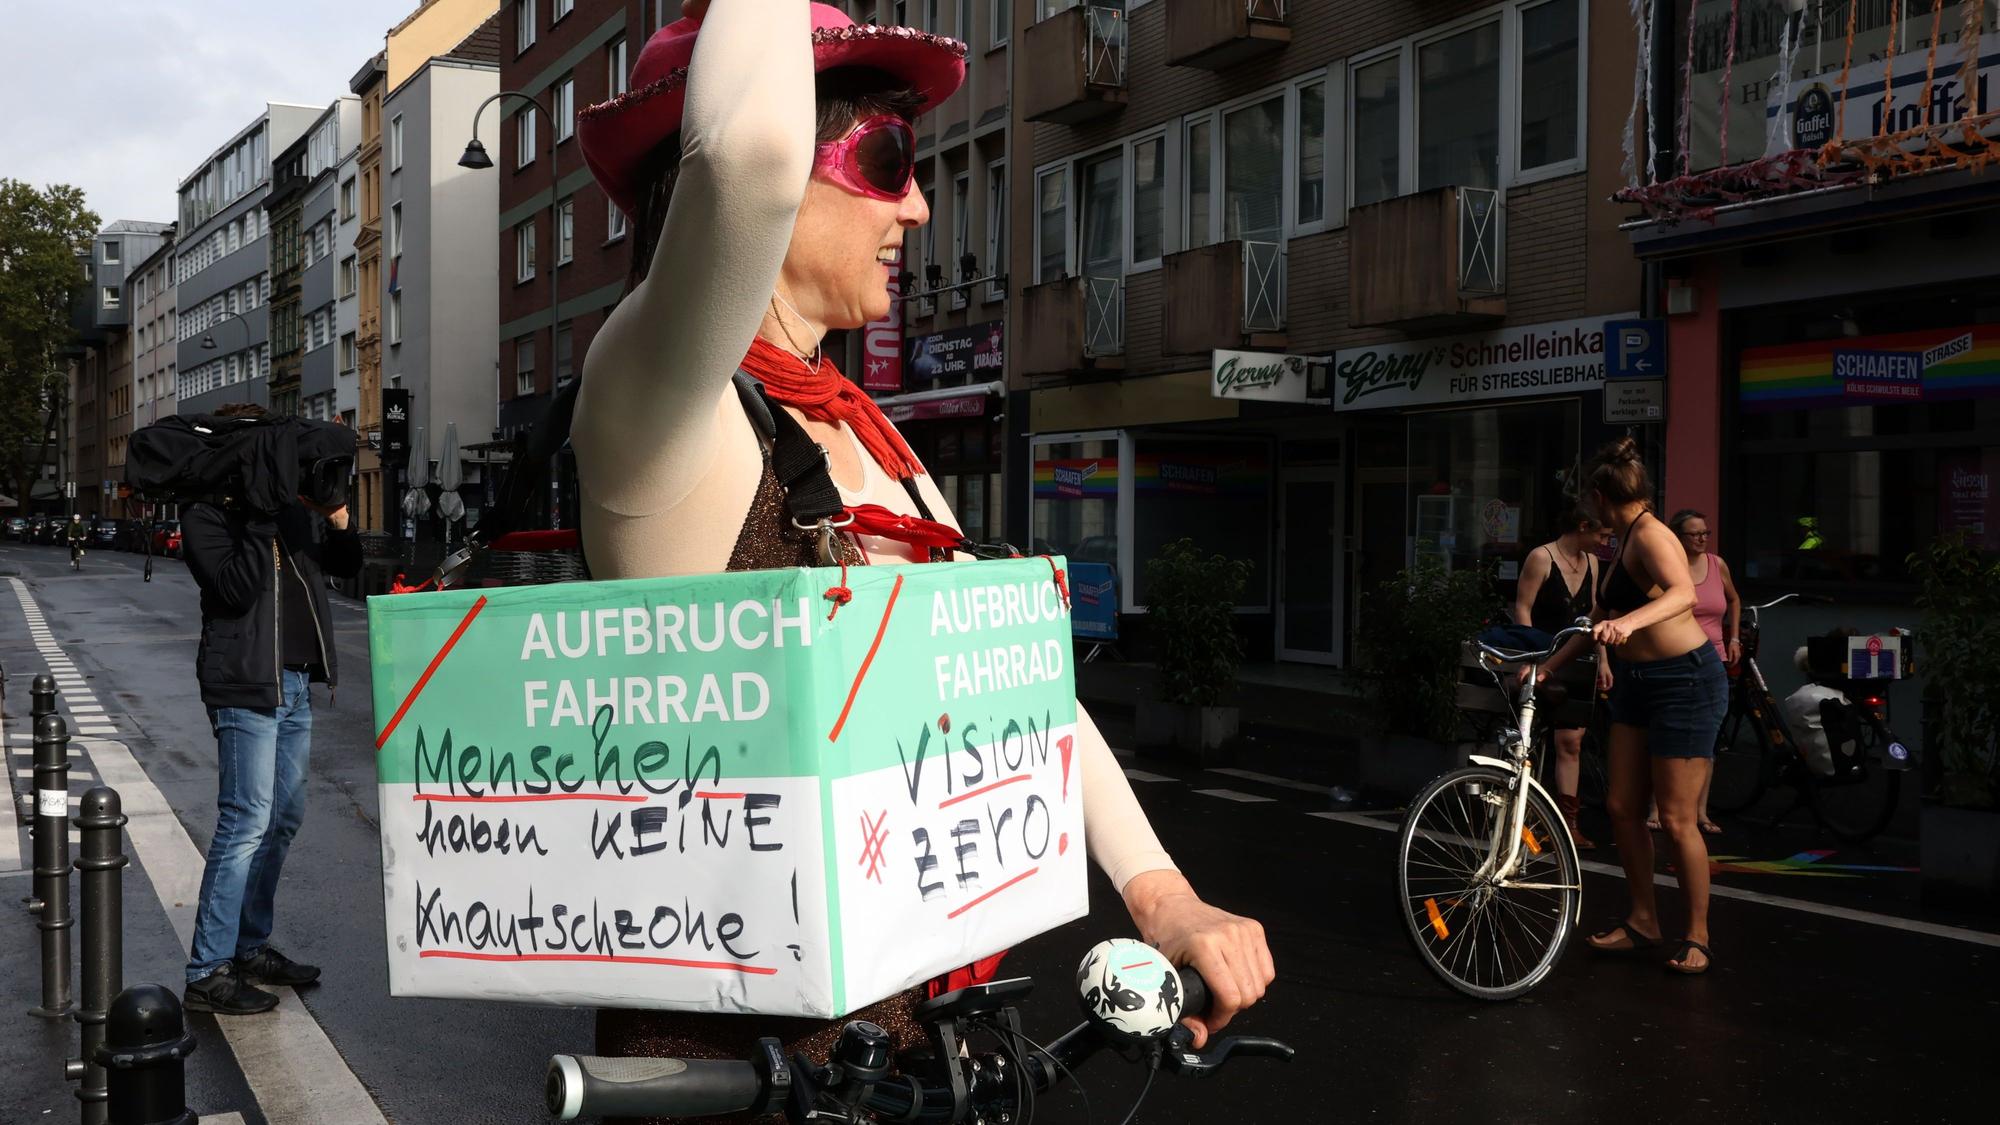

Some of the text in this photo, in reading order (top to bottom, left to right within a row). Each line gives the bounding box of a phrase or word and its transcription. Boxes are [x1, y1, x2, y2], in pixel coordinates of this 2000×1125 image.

[1797, 113, 1831, 134] Gaffel
[929, 337, 1003, 369] DIENSTAG KARAOKE
[931, 364, 943, 374] 22
[1619, 328, 1650, 370] P
[1836, 335, 1969, 379] SCHAAFEN STRASSE
[1449, 374, 1477, 394] FÜR
[521, 597, 812, 660] AUFBRUCH
[935, 639, 1063, 701] FAHRRAD
[523, 672, 770, 727] FAHRRAD
[414, 704, 721, 798] Menschen
[416, 800, 548, 857] haben
